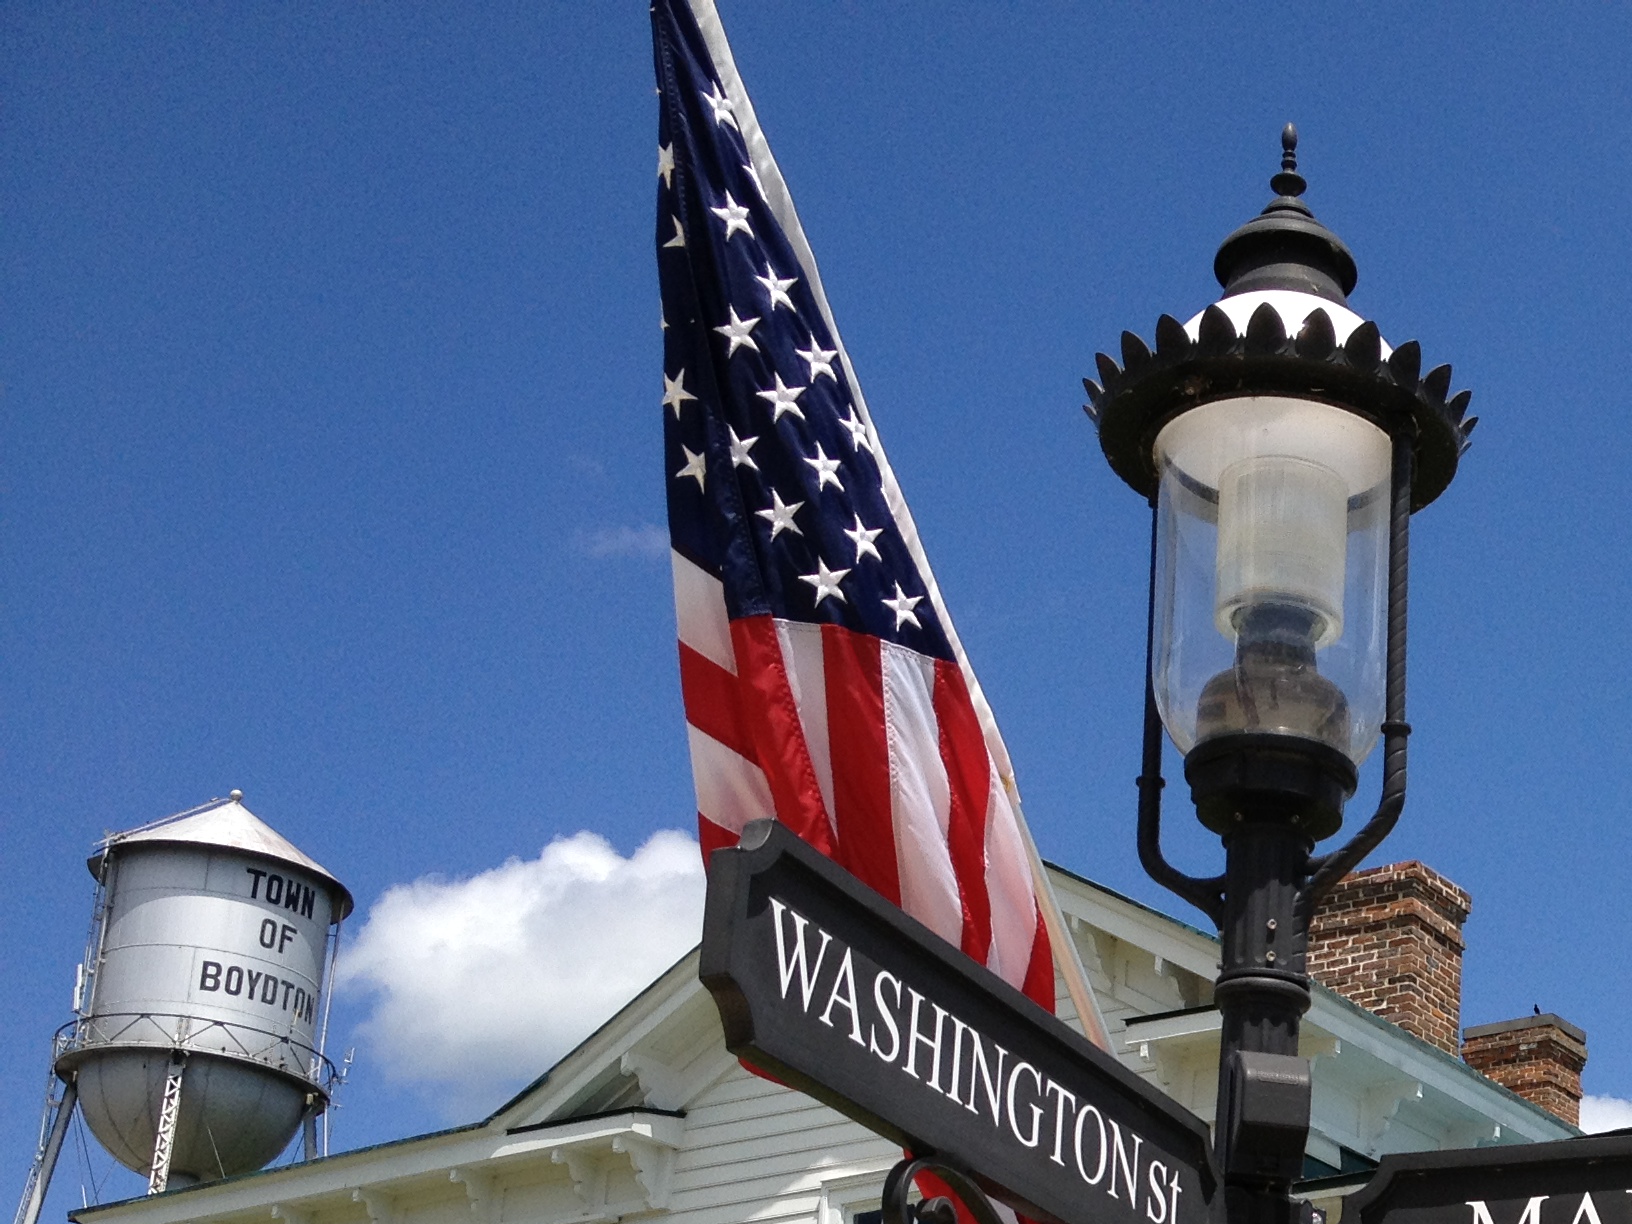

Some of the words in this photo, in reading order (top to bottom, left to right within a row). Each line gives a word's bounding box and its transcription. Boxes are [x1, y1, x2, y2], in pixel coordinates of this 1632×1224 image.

[247, 867, 315, 920] TOWN
[259, 918, 298, 954] OF
[199, 960, 315, 1025] BOYDTON
[768, 895, 1143, 1211] WASHINGTON
